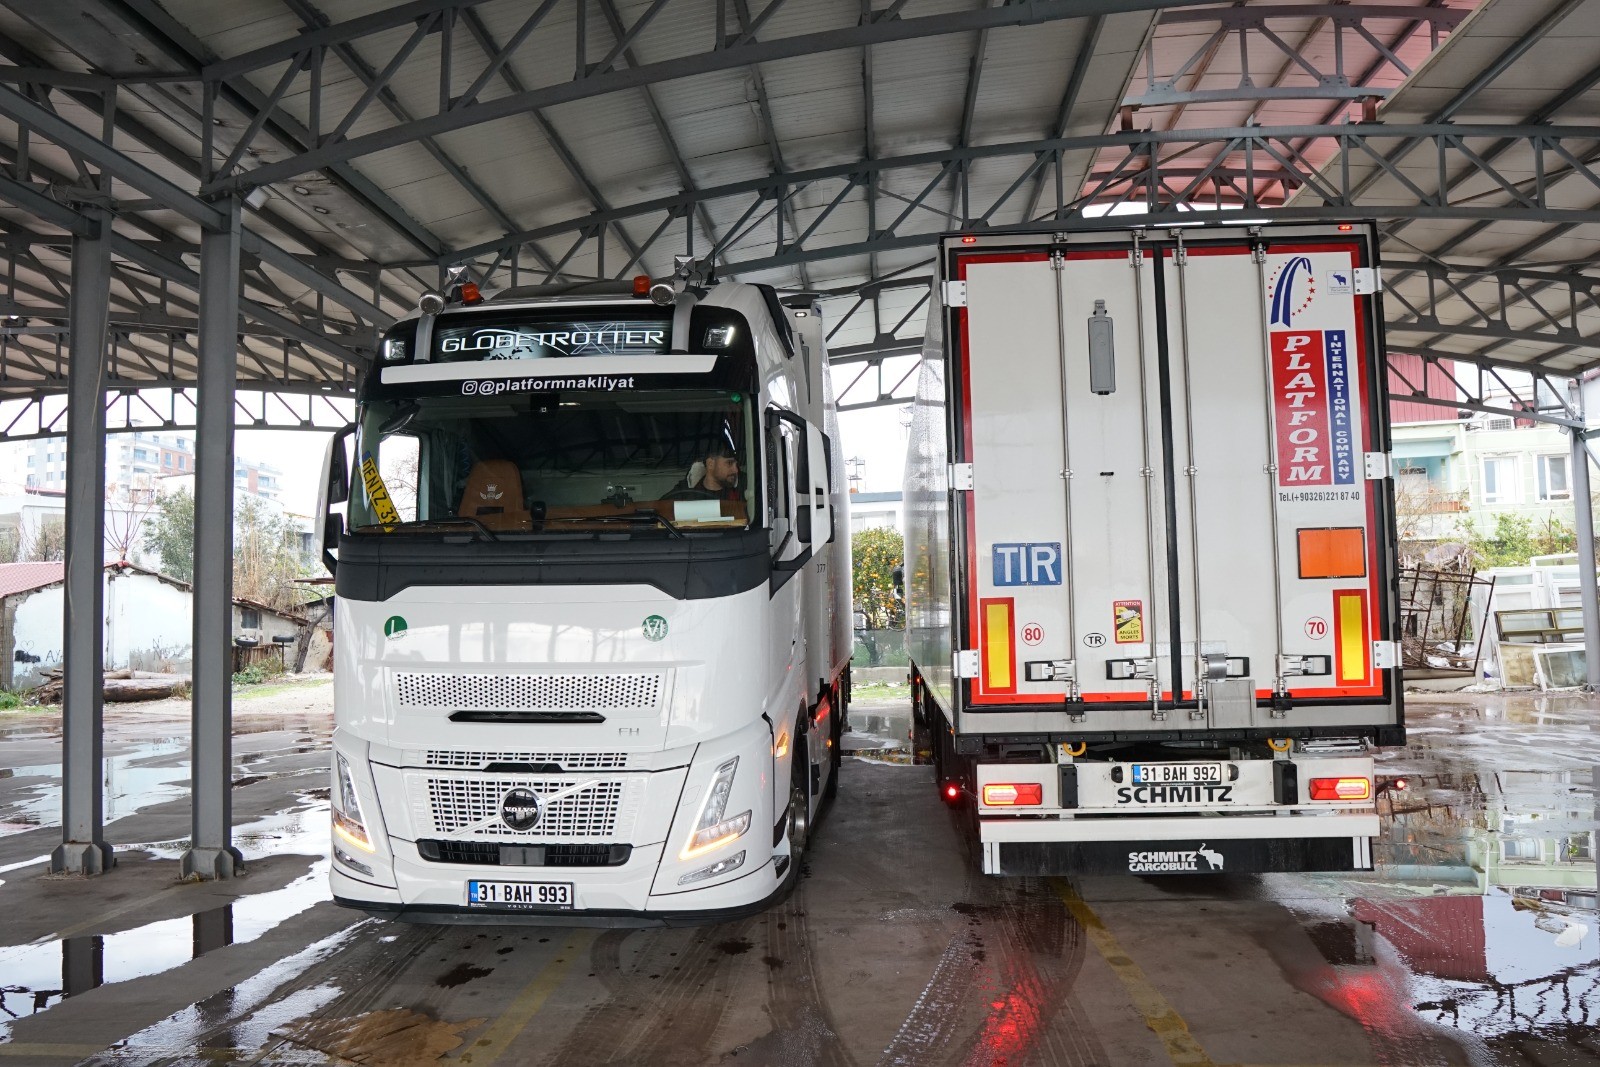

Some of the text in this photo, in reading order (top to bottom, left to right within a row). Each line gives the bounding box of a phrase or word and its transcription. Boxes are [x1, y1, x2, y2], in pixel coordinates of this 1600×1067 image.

[442, 330, 664, 352] GLOBETROTTER
[478, 376, 635, 395] @platformnakliyat
[1283, 335, 1325, 482] PLATFORM
[1330, 335, 1350, 479] INTERNATIONAL COMPANY
[997, 546, 1057, 583] TIR
[1024, 627, 1042, 641] 80
[1307, 621, 1325, 635] 70
[1088, 636, 1102, 645] TR
[618, 727, 640, 736] FH
[1141, 766, 1217, 781] 31 BAH 992
[1117, 786, 1233, 804] SCHMITZ
[1128, 851, 1197, 862] SCHMITZ
[1128, 862, 1198, 872] CARGOBULL
[479, 884, 567, 903] 31 BAH 993
